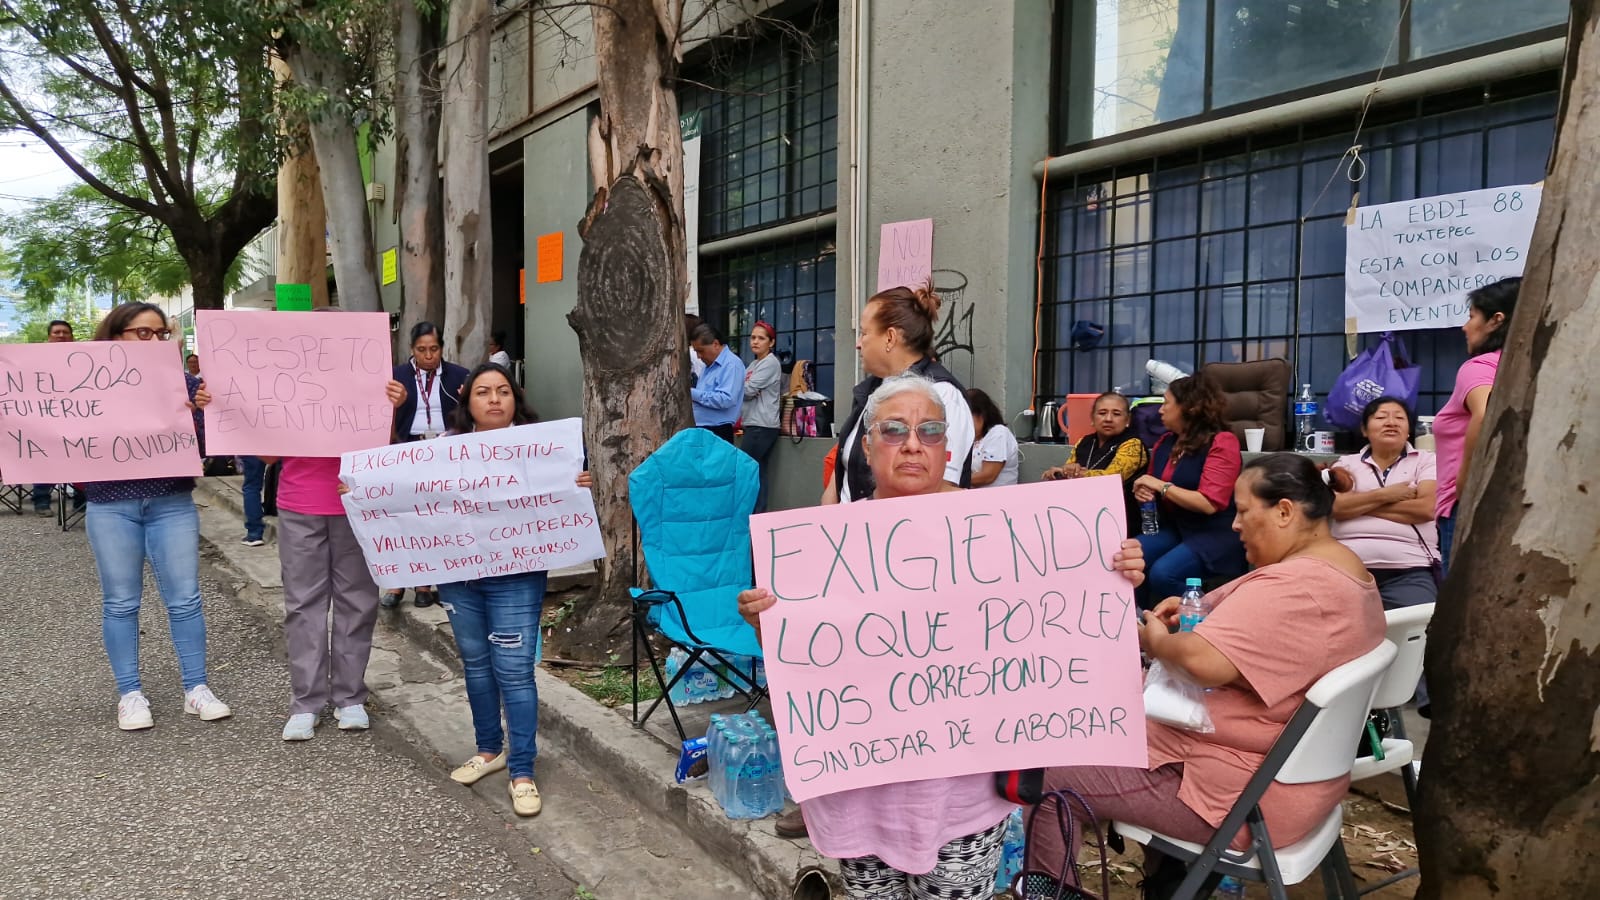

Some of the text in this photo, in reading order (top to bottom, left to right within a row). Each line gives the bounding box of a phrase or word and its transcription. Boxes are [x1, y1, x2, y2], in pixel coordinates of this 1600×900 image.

[1360, 191, 1523, 230] LA EBDI 88
[1393, 226, 1475, 244] TUXTEPEC
[1359, 246, 1519, 274] ESTA CON LOS
[203, 318, 385, 375] RESPETO
[0, 344, 142, 397] N EL 2020
[221, 371, 328, 405] A LOS
[215, 402, 393, 433] EVENTUALES
[8, 429, 48, 459] YA
[62, 435, 104, 460] ME
[351, 441, 564, 473] EXIGIMOS LA DESTITU-
[352, 474, 520, 501] CION INMEDIATA
[361, 508, 399, 521] DEL
[452, 499, 500, 516] ABEL
[506, 493, 564, 510] URIEL
[372, 512, 594, 553] VALLADARES CONTRERAS
[370, 563, 400, 577] JEFE
[409, 561, 437, 574] DEL
[489, 551, 504, 563] DE
[512, 537, 580, 560] RECURSOS
[477, 557, 545, 579] HUMANOS
[767, 506, 1122, 601] EXIGIENDO
[855, 610, 954, 658] QUE
[786, 653, 1090, 737] NOS CORRESPONDE
[994, 706, 1128, 745] LABORAR
